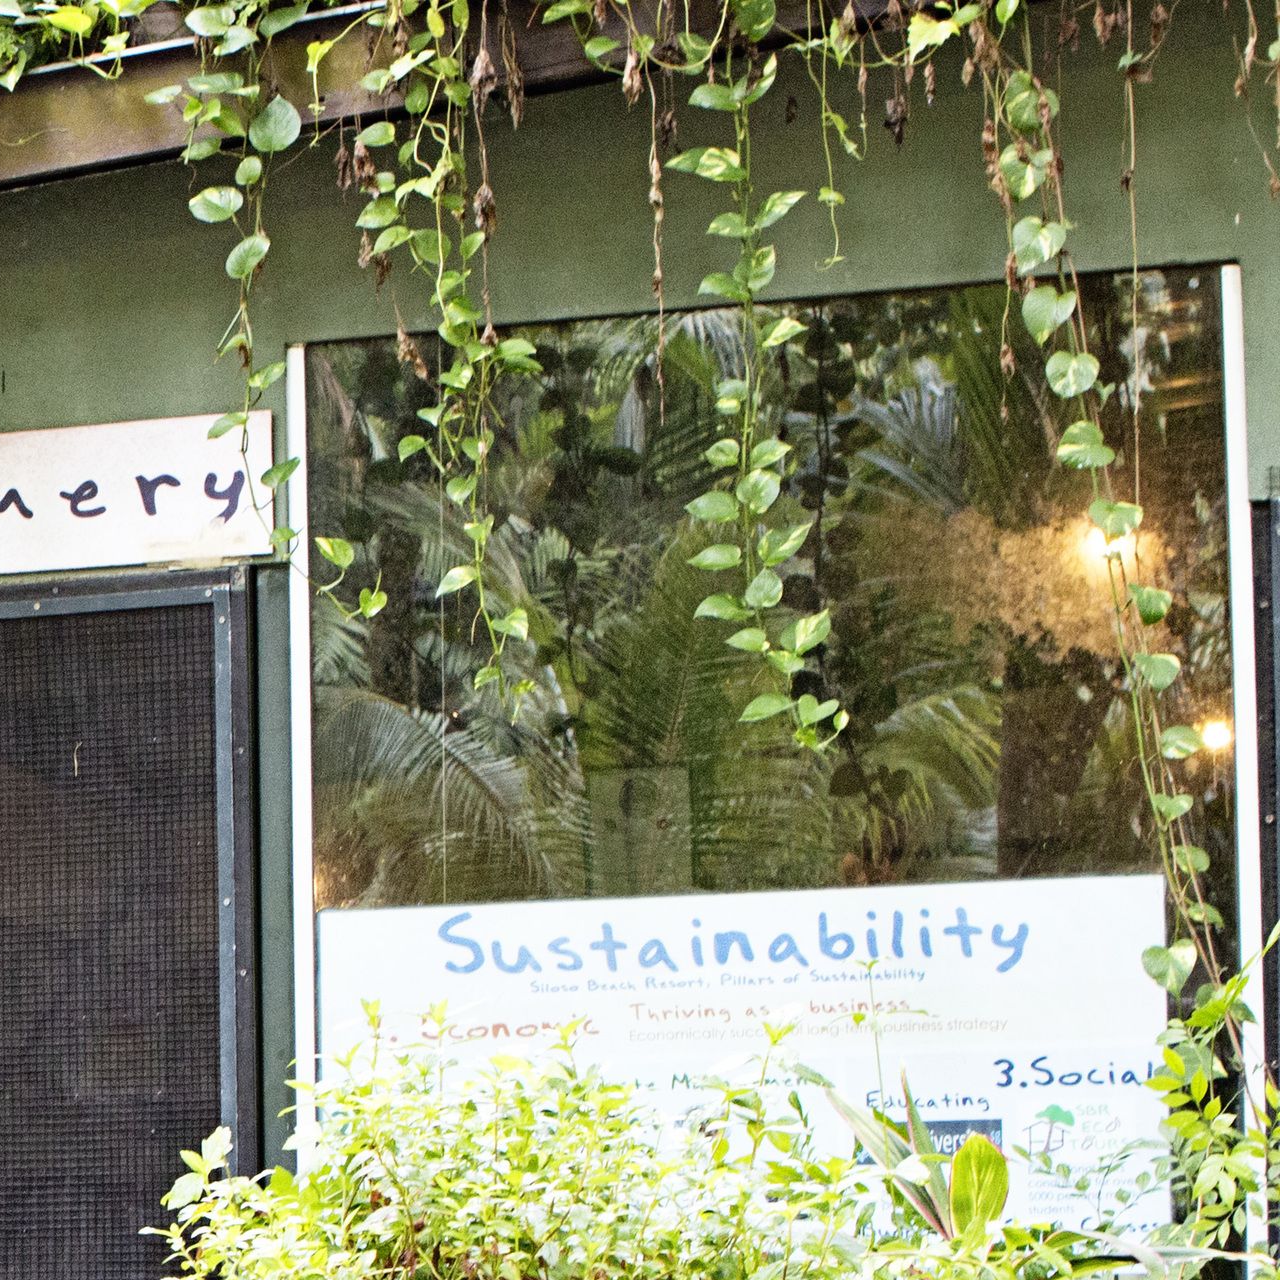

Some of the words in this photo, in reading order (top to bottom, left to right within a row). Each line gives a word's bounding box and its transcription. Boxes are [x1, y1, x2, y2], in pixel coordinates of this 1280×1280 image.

[438, 906, 1031, 974] Sustainability
[530, 979, 579, 994] Siloso
[587, 978, 636, 992] Beach
[720, 973, 775, 987] Pillars
[783, 973, 799, 984] of
[810, 968, 926, 983] Sustainability
[629, 1002, 731, 1024] Thriving
[745, 1005, 770, 1017] as
[810, 999, 910, 1014] business
[629, 1027, 726, 1043] Economically
[947, 1017, 1009, 1034] strategy
[1075, 1103, 1110, 1116] SBR
